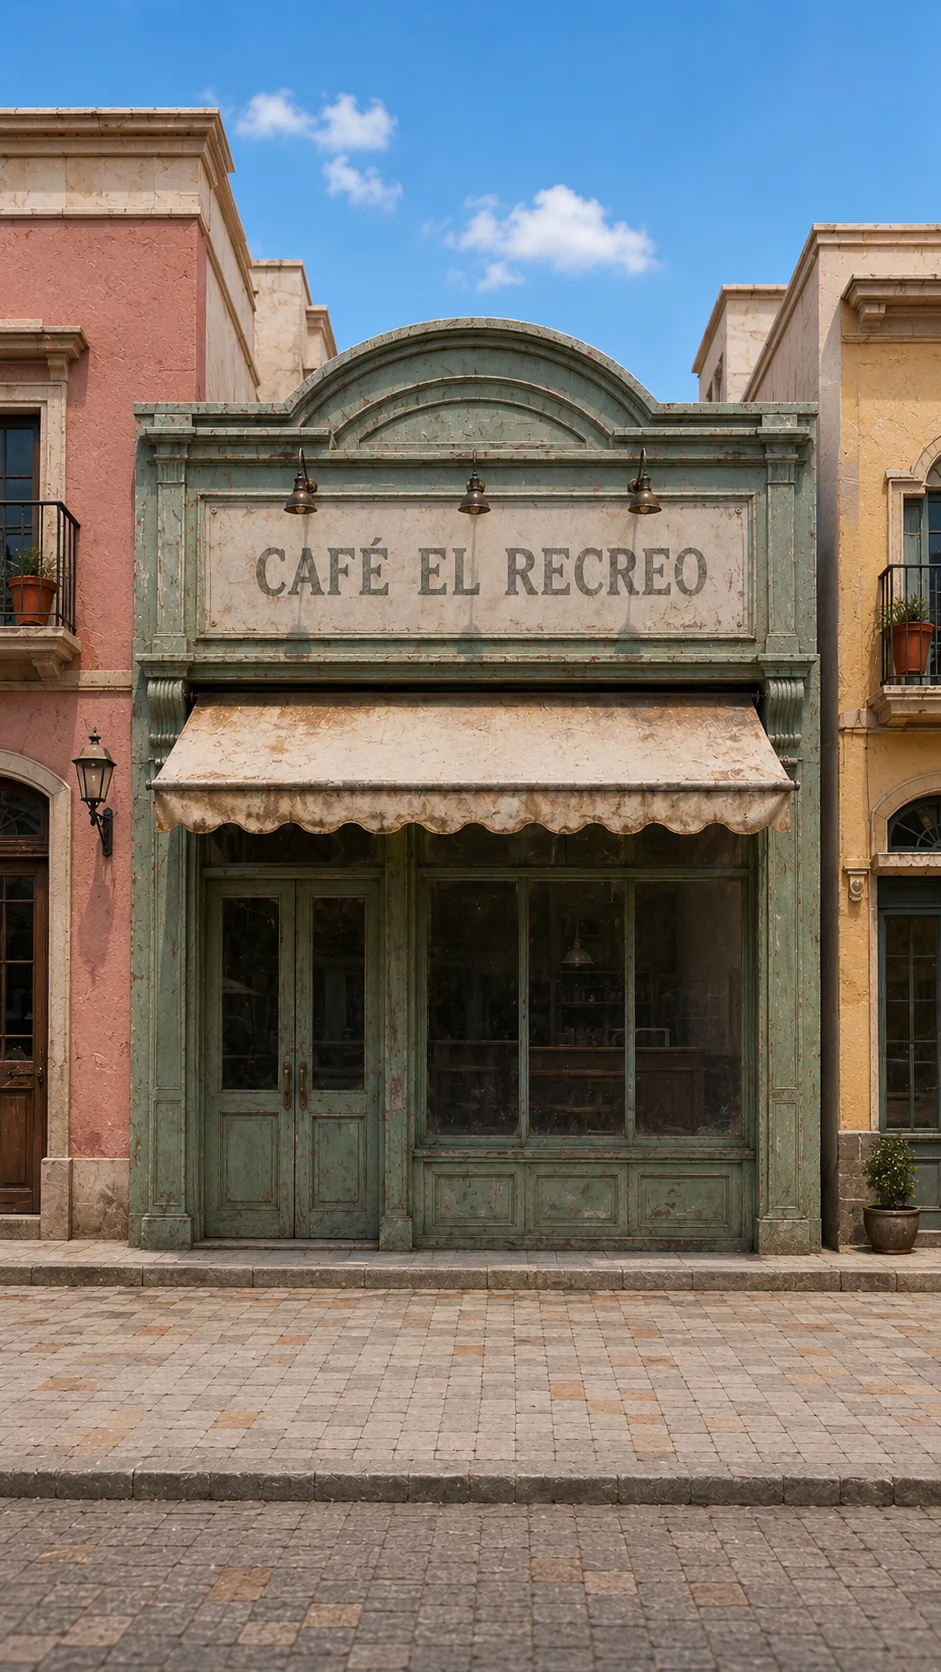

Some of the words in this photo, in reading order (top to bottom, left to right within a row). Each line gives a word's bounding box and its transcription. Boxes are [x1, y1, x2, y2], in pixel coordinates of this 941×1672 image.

[255, 537, 390, 598] CAFÉ
[418, 547, 481, 597] EL
[504, 547, 709, 598] RECREO
